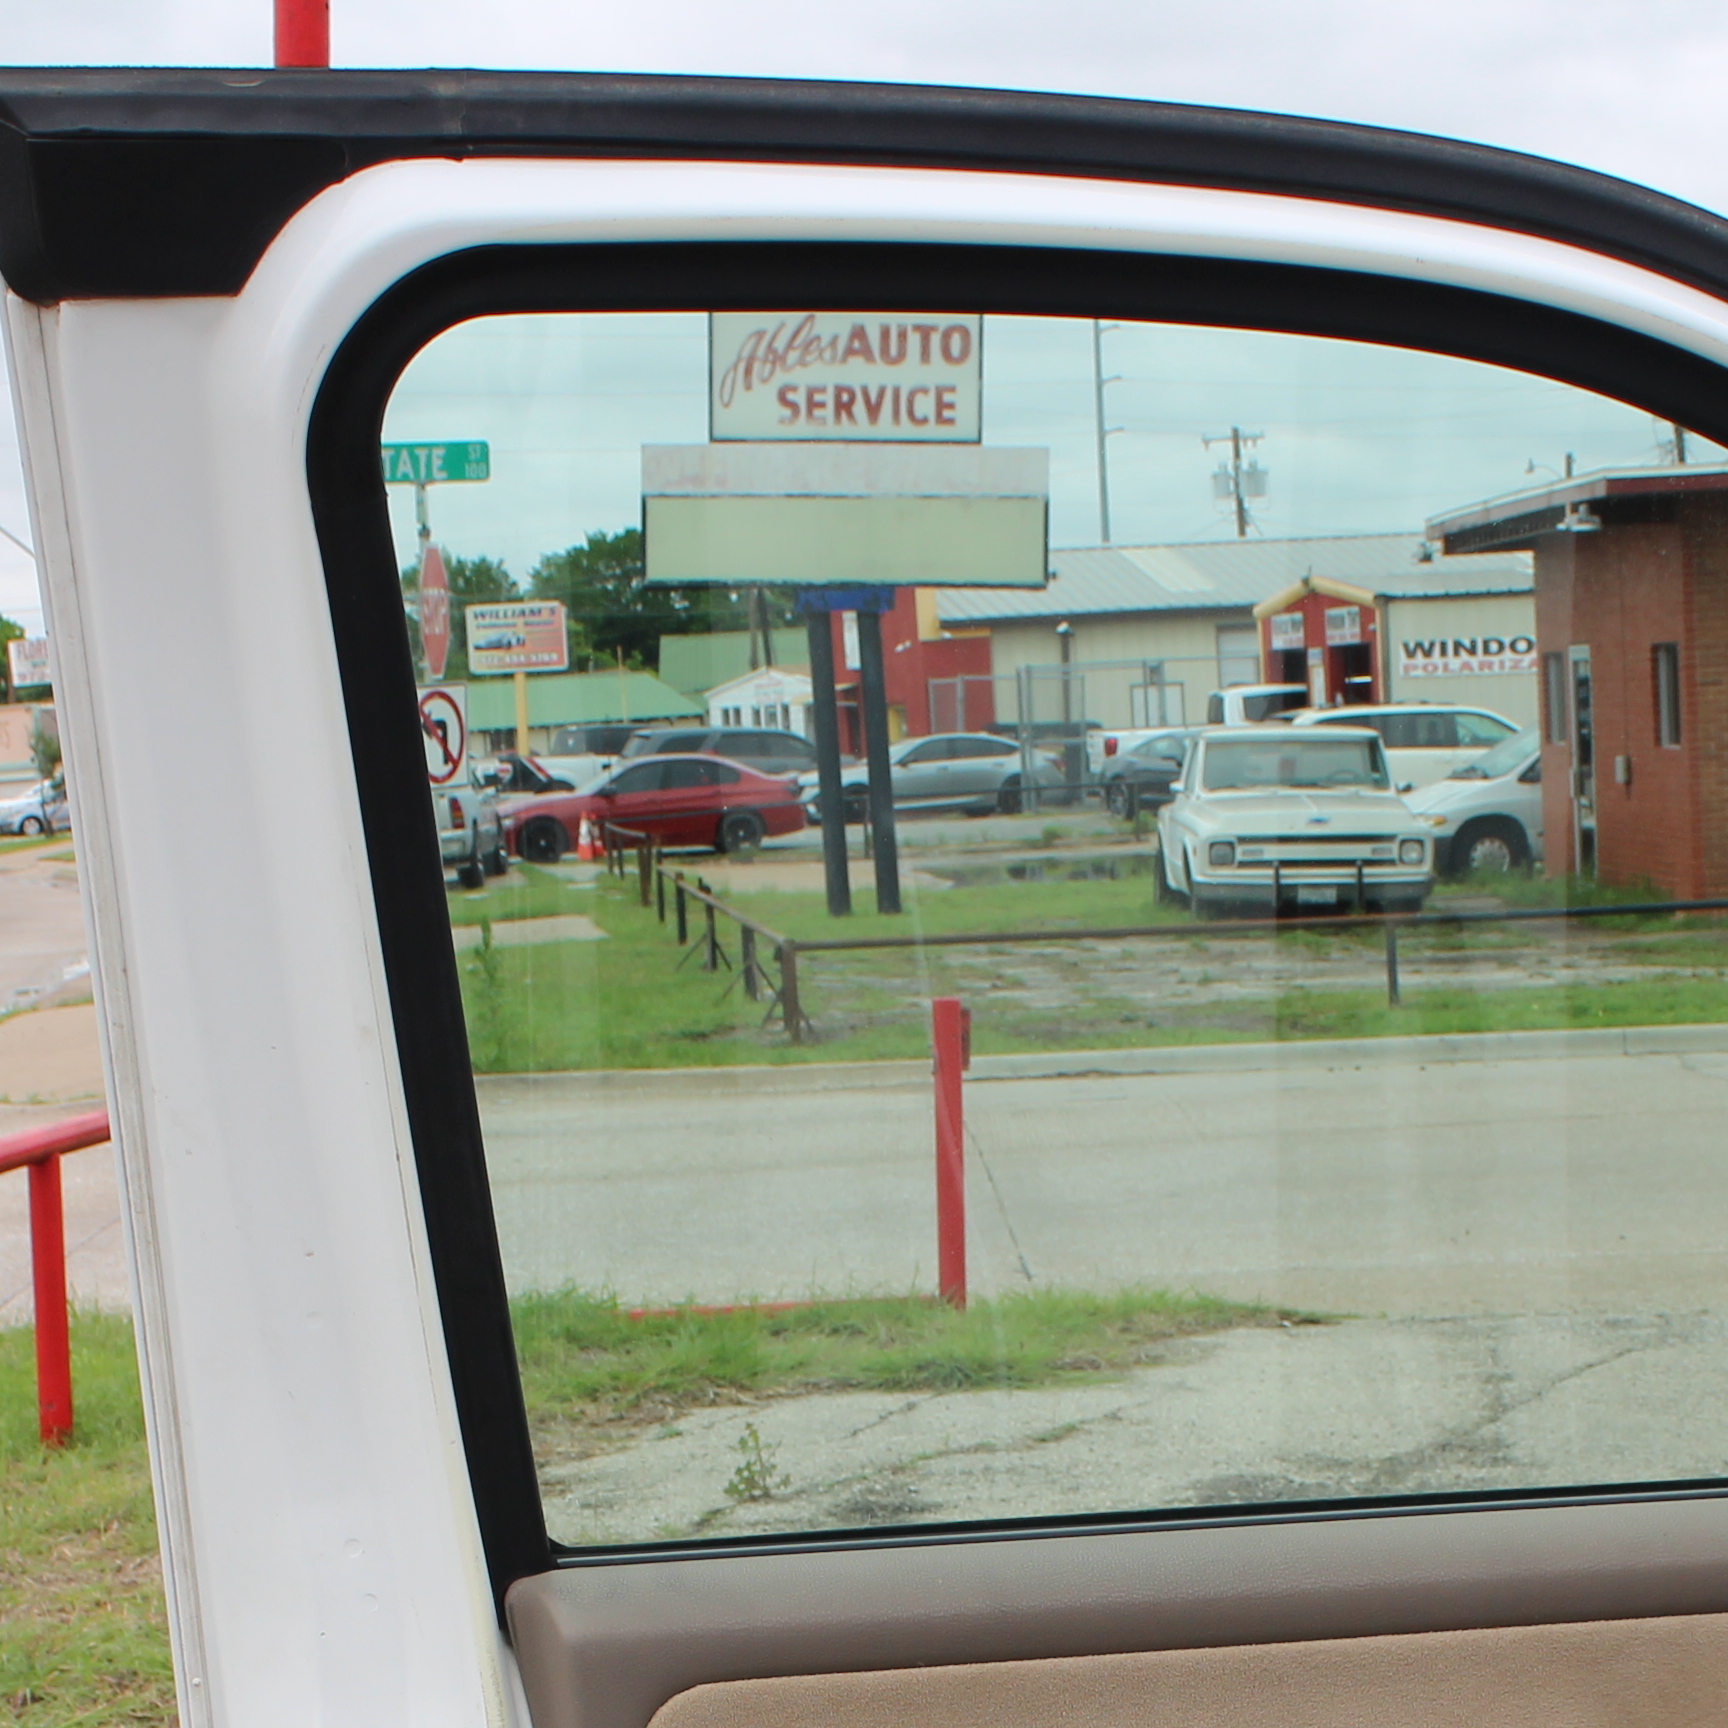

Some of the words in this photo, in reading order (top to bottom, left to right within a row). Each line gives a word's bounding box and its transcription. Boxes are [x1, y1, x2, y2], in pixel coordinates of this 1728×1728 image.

[720, 314, 840, 408] Ables
[840, 323, 972, 366] AUTO
[777, 383, 958, 426] SERVICE
[381, 446, 448, 480] TATE
[422, 587, 448, 635] STOP
[1402, 636, 1535, 660] WINDO
